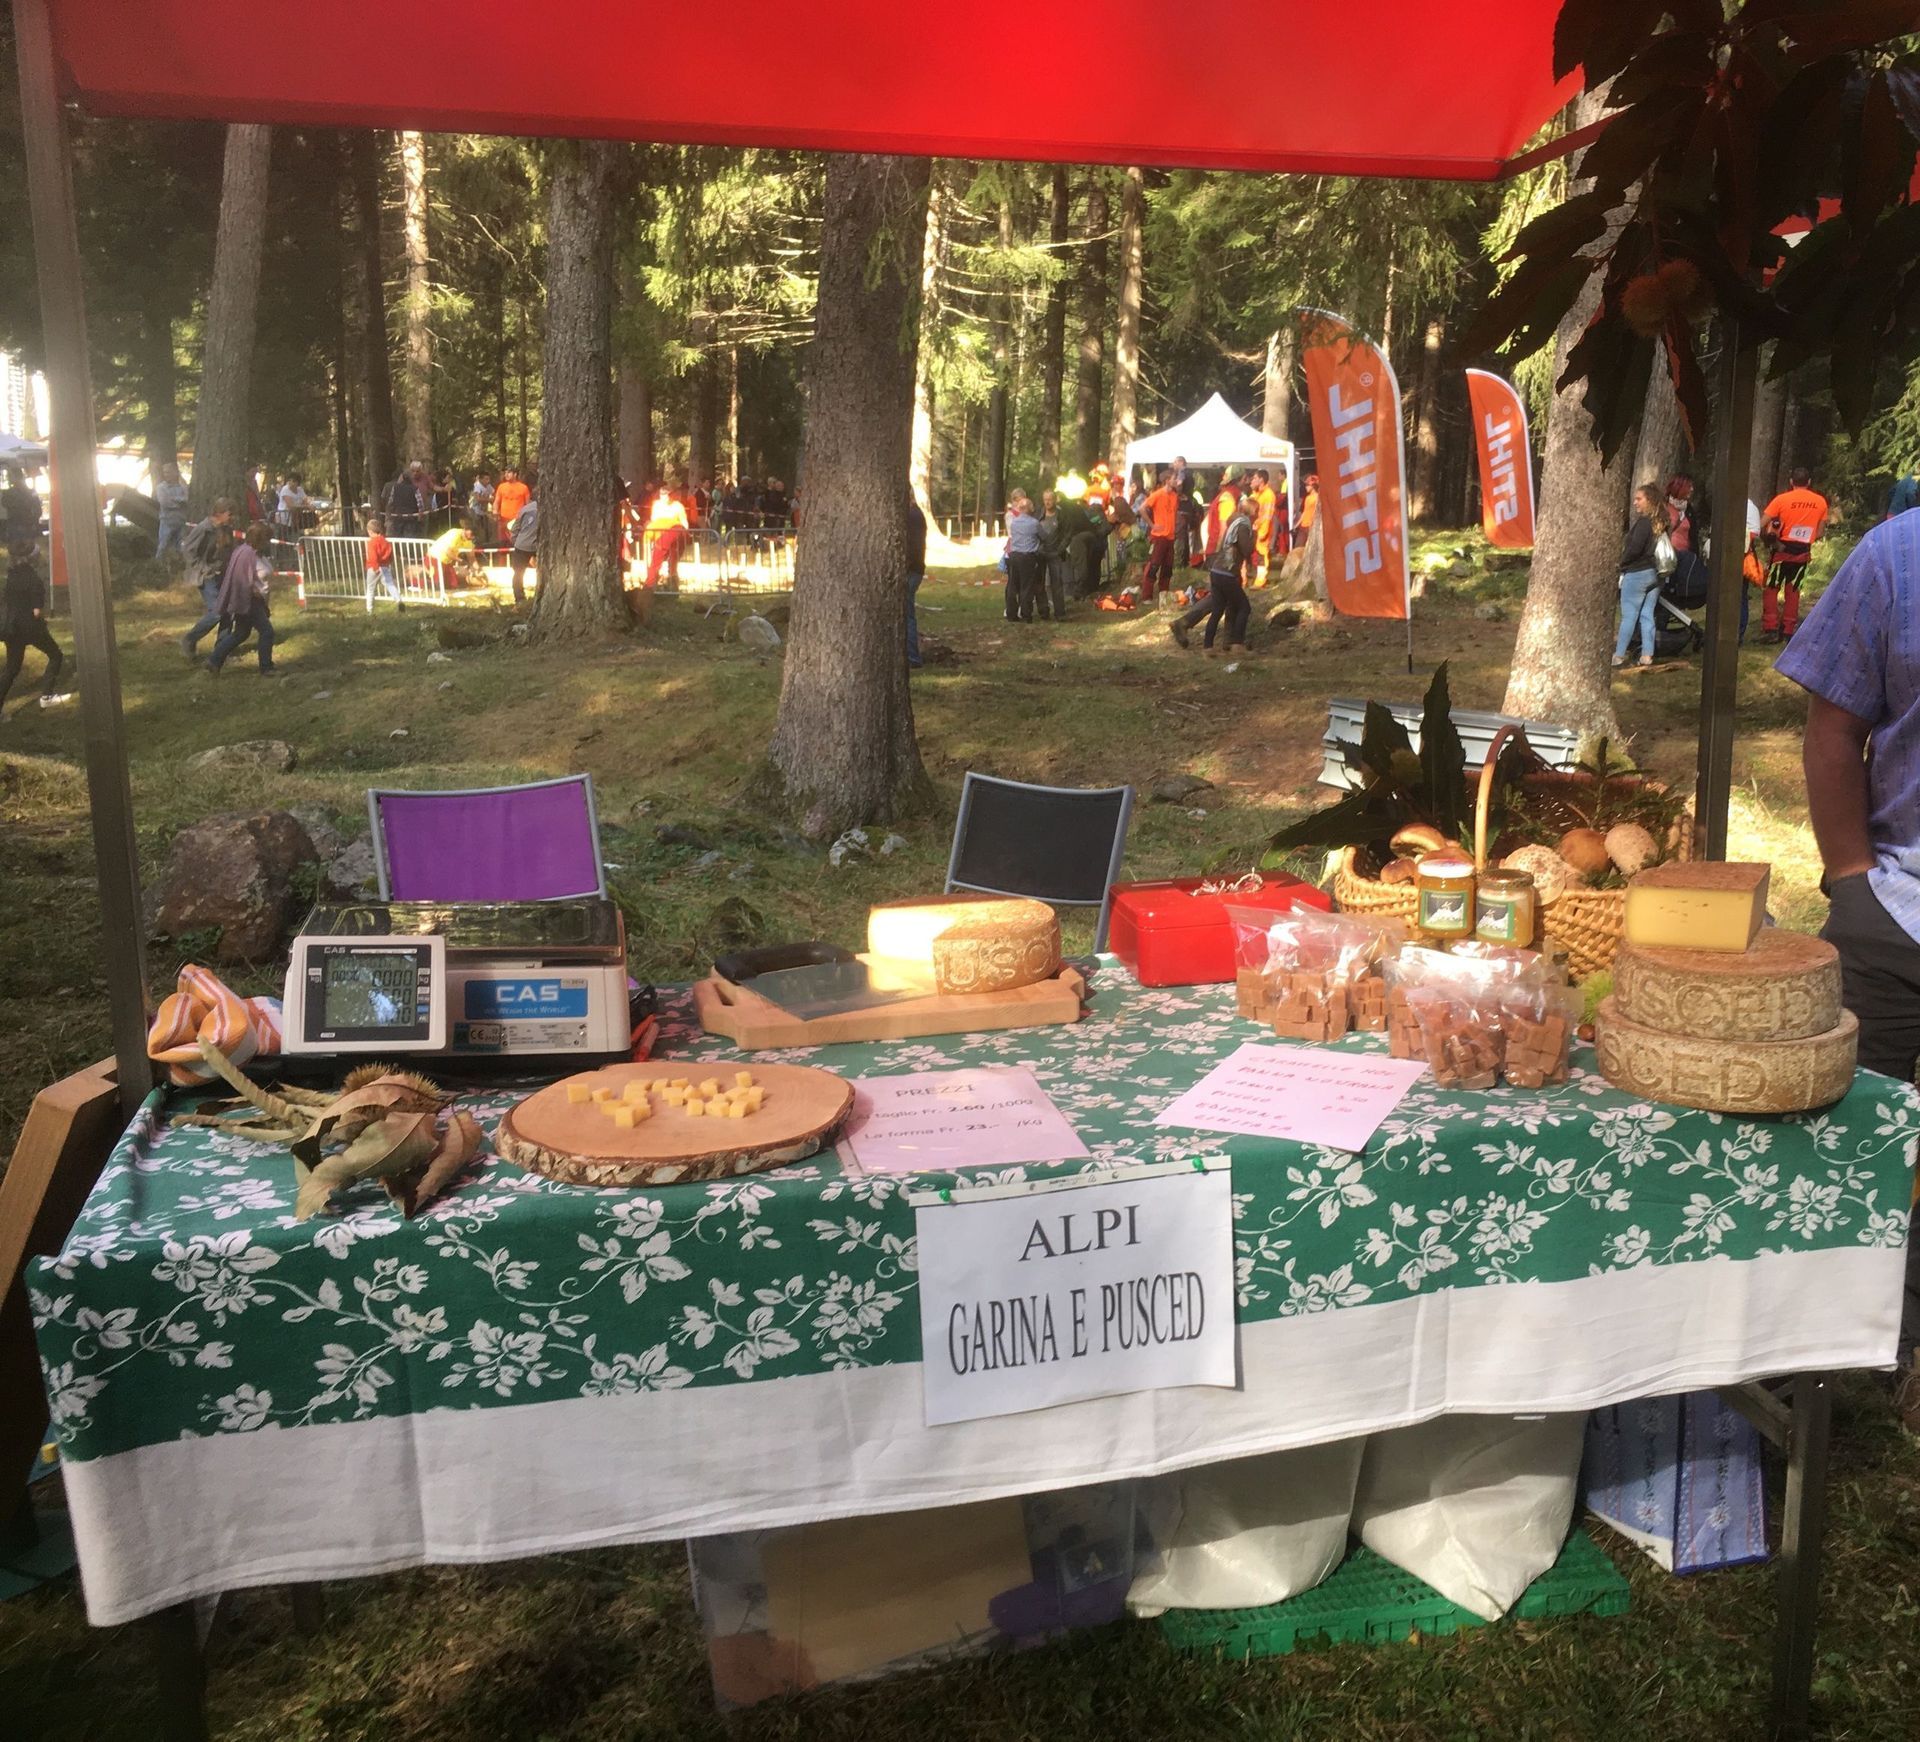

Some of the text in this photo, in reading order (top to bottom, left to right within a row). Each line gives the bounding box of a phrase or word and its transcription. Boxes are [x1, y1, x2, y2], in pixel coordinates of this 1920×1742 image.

[1790, 502, 1818, 510] STIHL
[1795, 529, 1807, 538] 61
[323, 946, 346, 954] CAS
[495, 984, 560, 1003] CAS
[895, 1084, 975, 1097] PREZZI
[874, 1110, 917, 1119] taglio
[922, 1107, 943, 1115] Fr.
[887, 1128, 934, 1138] forma
[938, 1126, 961, 1134] Fr.
[1018, 1204, 1142, 1263] ALPI
[949, 1271, 1205, 1376] GARINA E PUSCED
